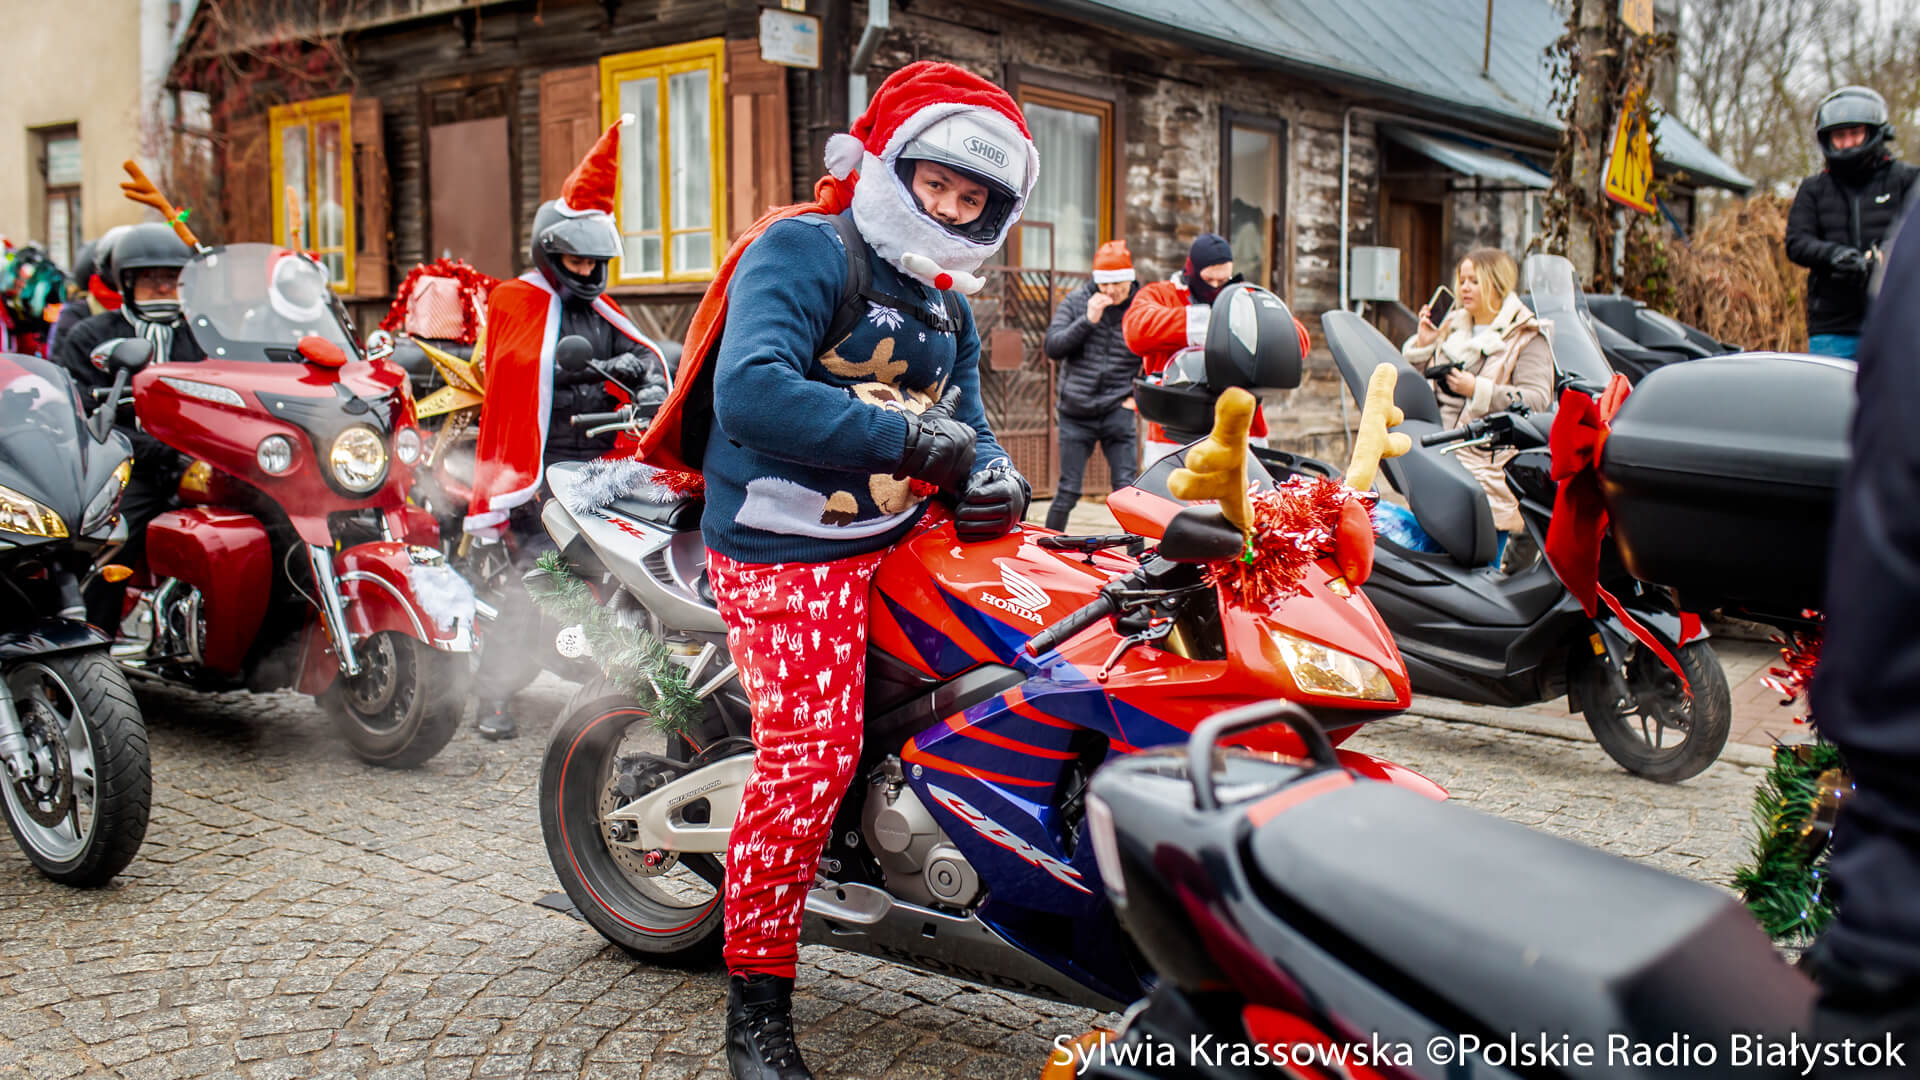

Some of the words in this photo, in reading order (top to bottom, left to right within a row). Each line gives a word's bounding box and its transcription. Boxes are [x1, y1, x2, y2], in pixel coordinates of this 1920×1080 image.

[970, 139, 1005, 166] SHOEI
[980, 591, 1044, 626] HONDA
[926, 783, 1094, 895] CBR
[876, 943, 1072, 999] HONDA
